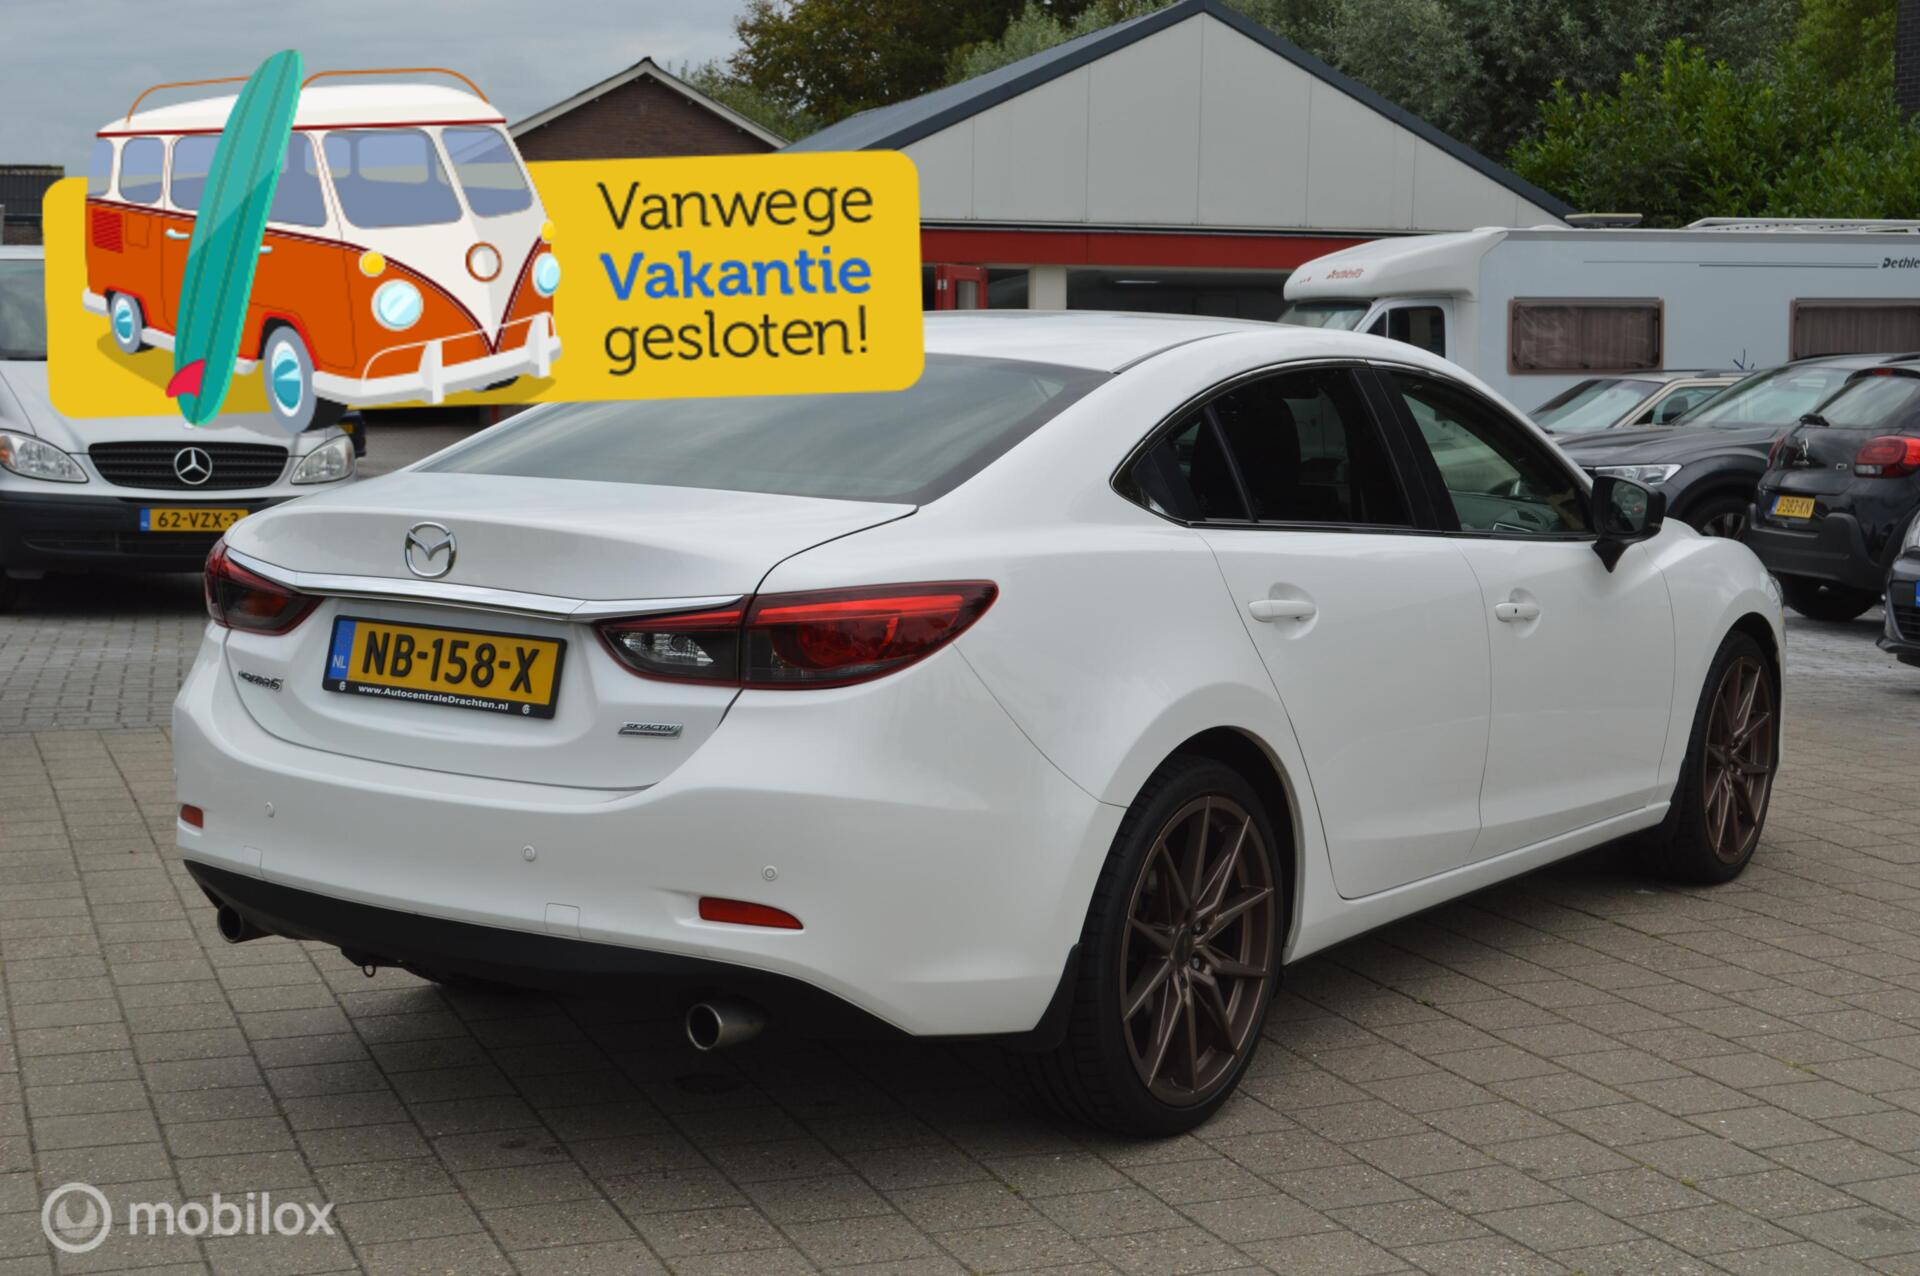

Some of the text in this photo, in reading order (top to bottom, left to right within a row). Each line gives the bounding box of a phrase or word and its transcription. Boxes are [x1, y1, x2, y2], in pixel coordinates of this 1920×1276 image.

[332, 654, 347, 669] NL
[362, 631, 540, 694] NB-158-X
[358, 685, 509, 711] www.AutocentraleDrachten.nl
